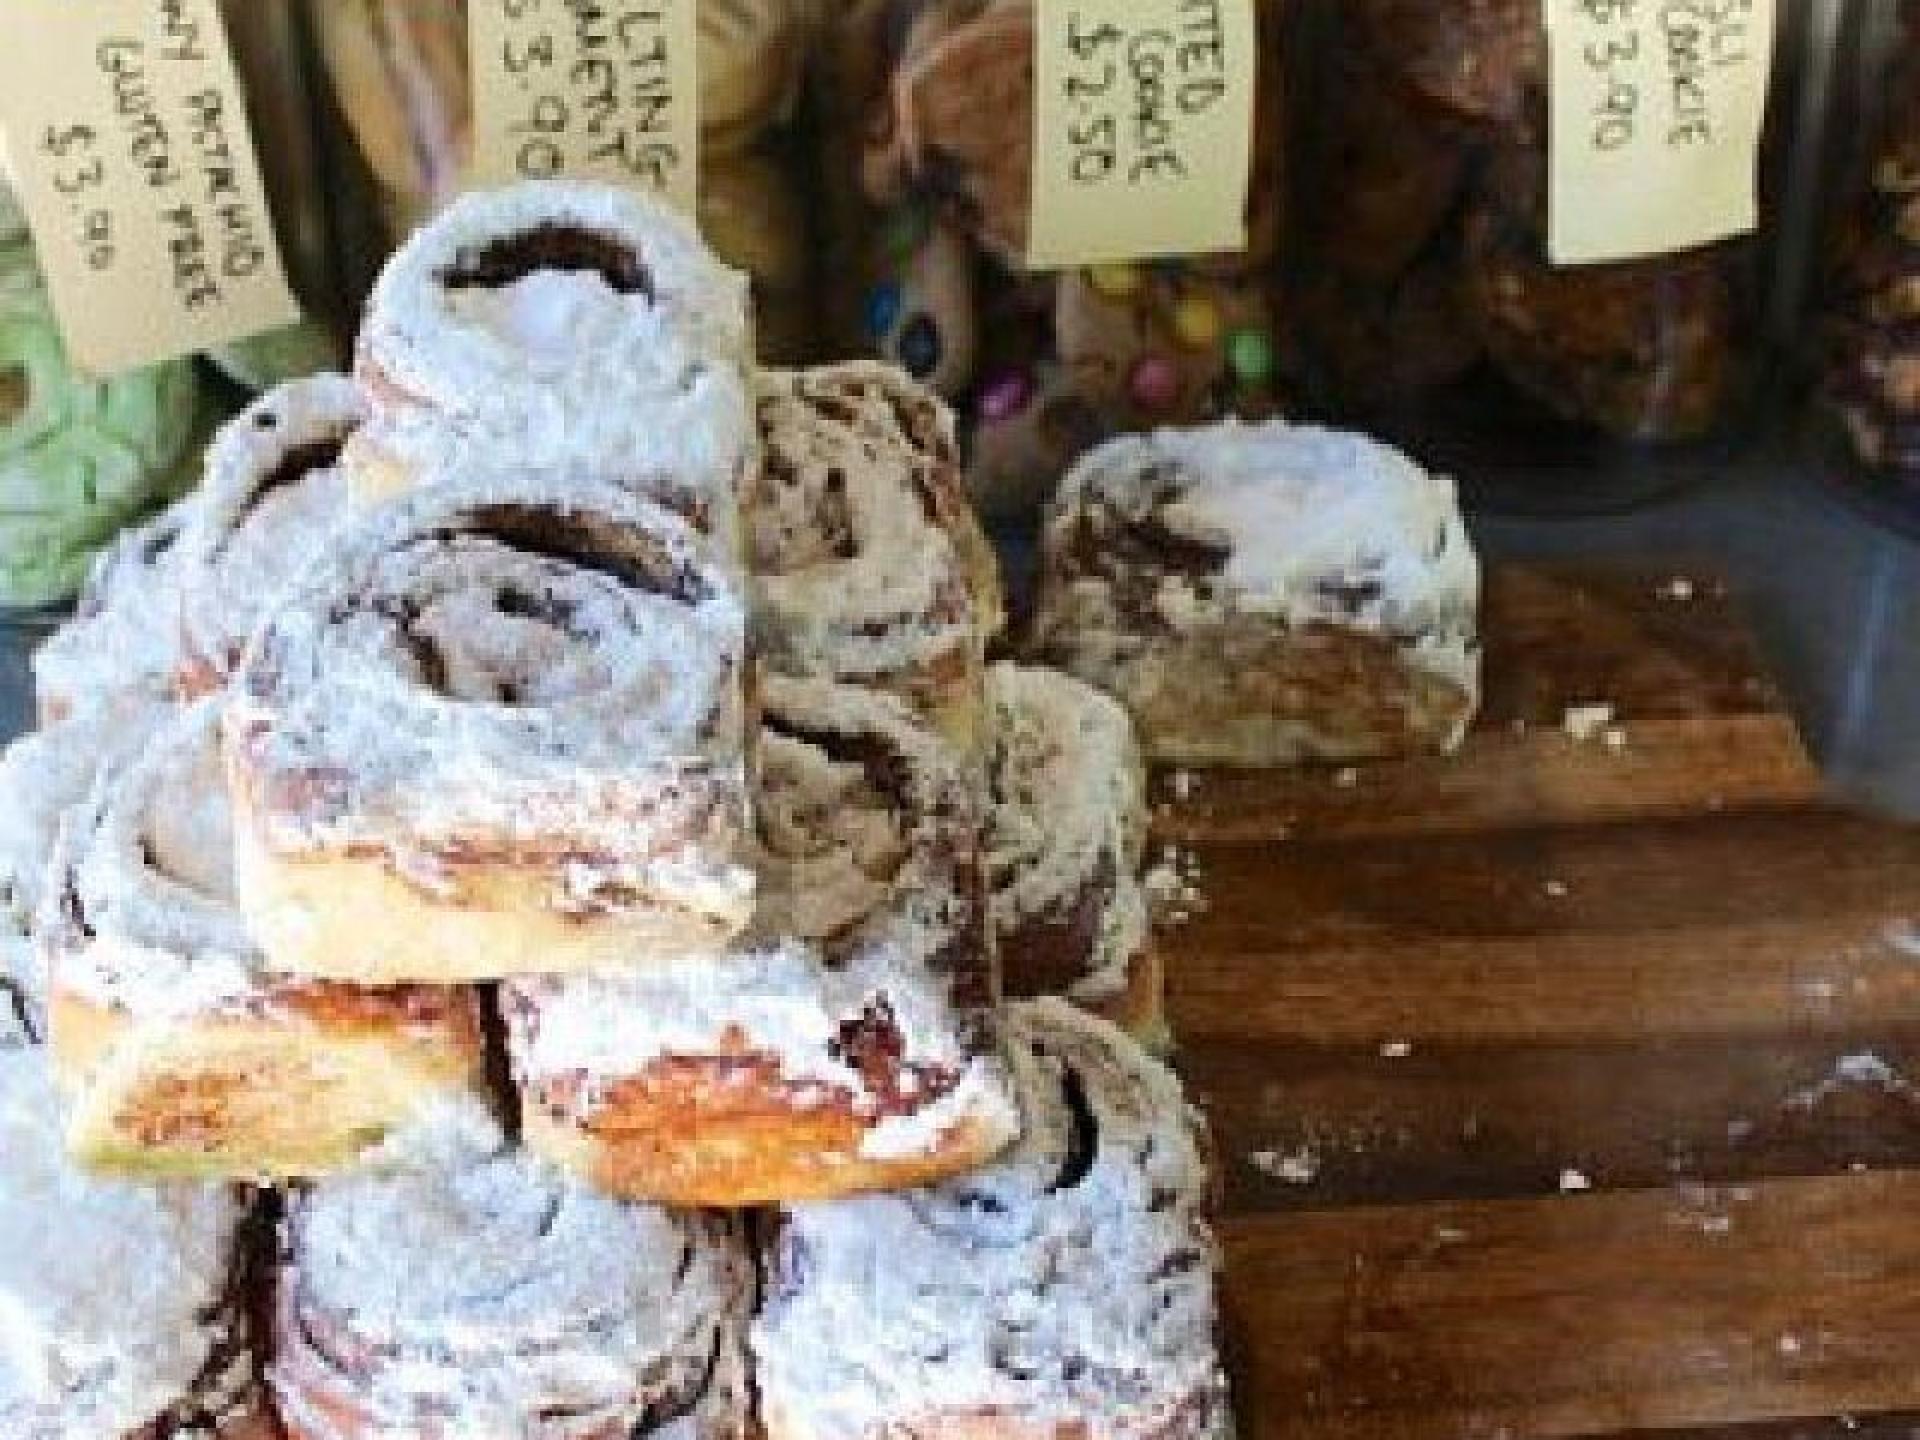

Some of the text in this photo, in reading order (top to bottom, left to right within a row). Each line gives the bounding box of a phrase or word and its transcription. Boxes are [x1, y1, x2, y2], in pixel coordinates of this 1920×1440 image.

[95, 40, 222, 312] GLUTEN FREE
[625, 5, 680, 190] LTING
[1063, 12, 1124, 184] $2.50
[1128, 28, 1188, 184] COOKIE
